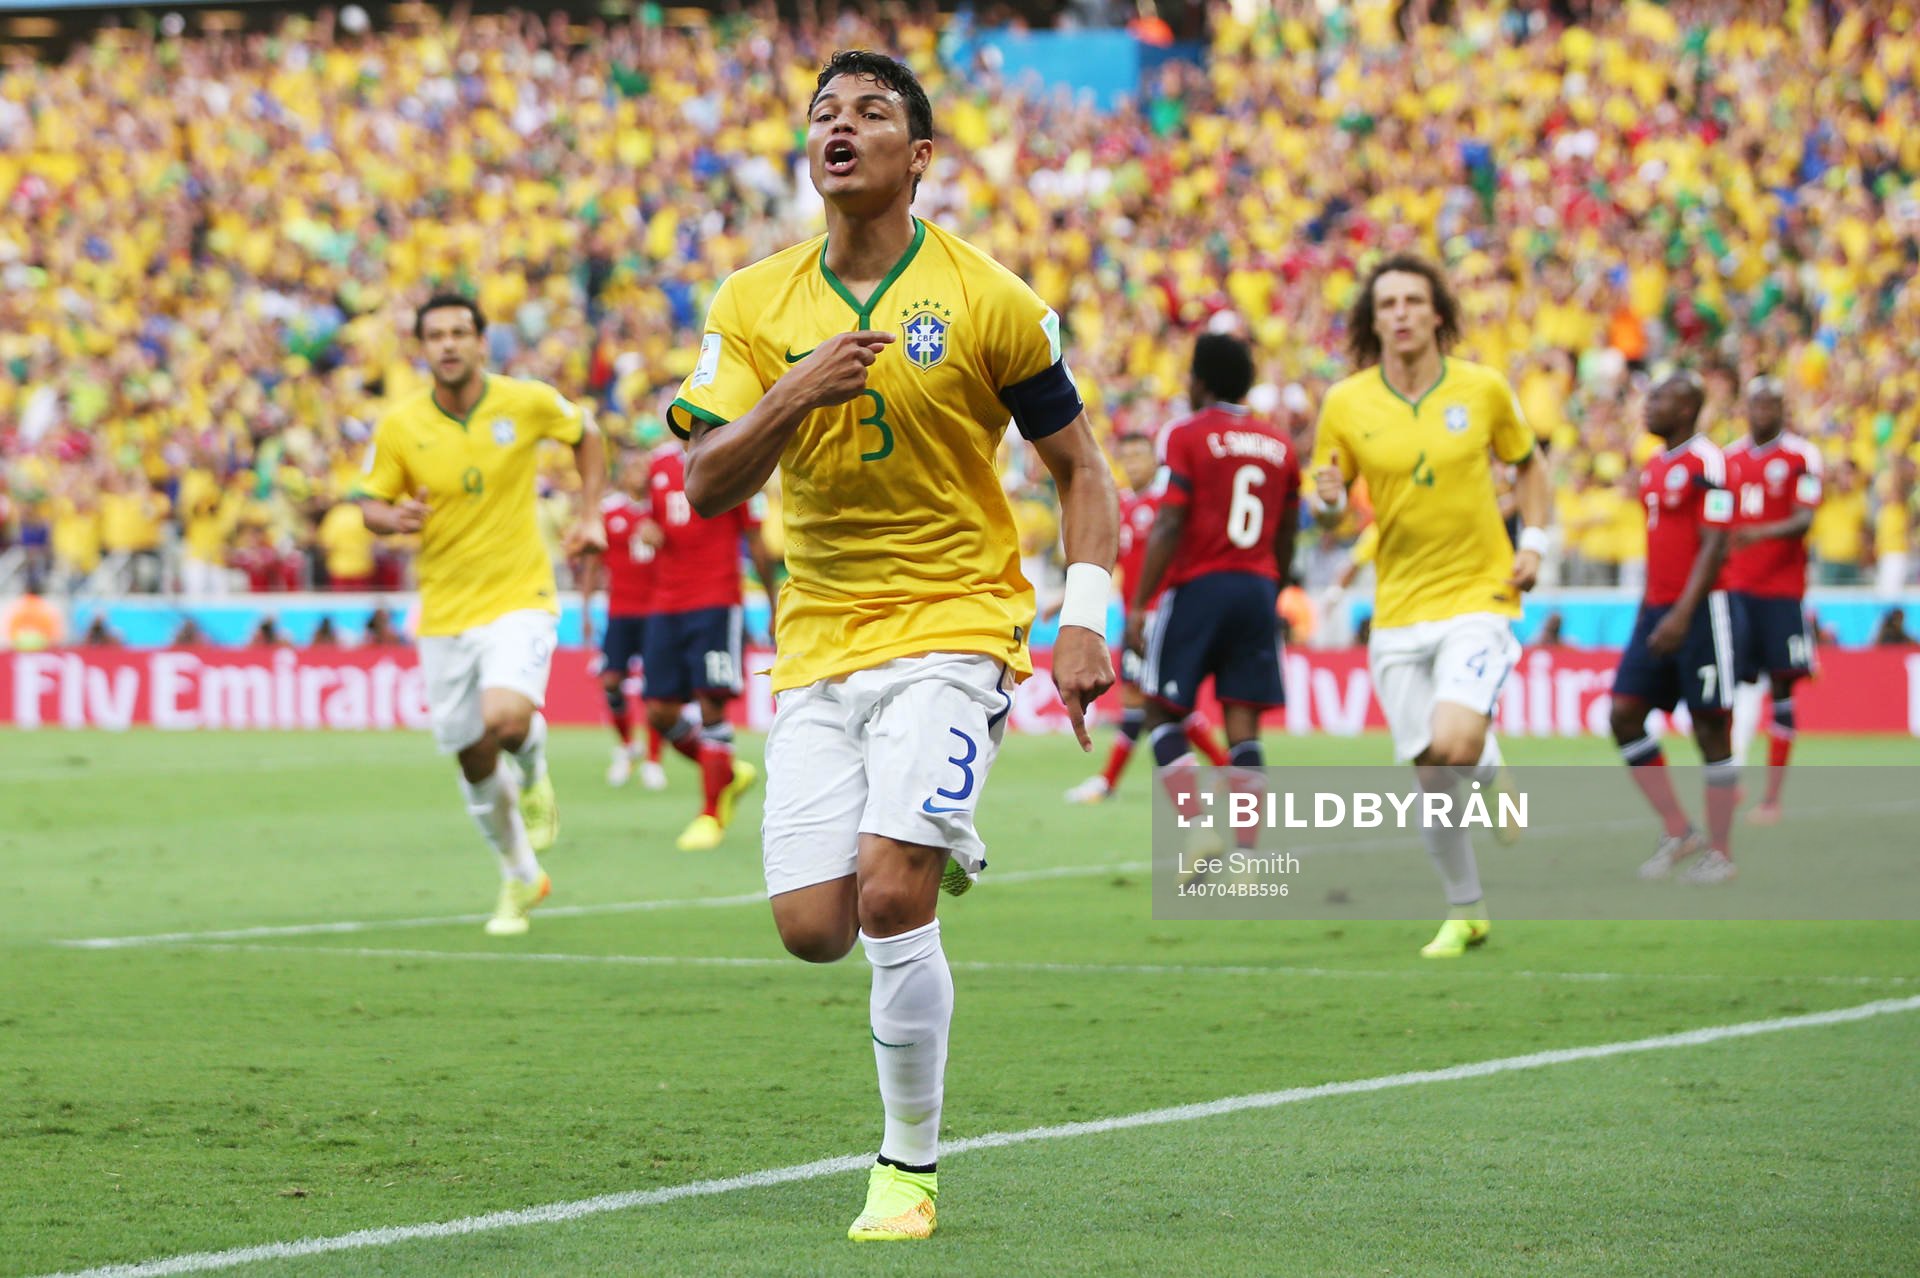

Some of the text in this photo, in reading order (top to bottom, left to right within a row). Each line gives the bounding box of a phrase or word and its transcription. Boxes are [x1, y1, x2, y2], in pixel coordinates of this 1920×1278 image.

[917, 334, 934, 342] CBF
[858, 388, 894, 462] 3
[1414, 451, 1434, 488] 4
[1227, 463, 1266, 549] 6
[531, 637, 549, 666] 9
[1466, 647, 1489, 678] 4
[12, 648, 432, 731] Fly Emirate
[1284, 652, 1372, 736] ly
[1696, 664, 1718, 702] 7
[936, 727, 978, 801] 3
